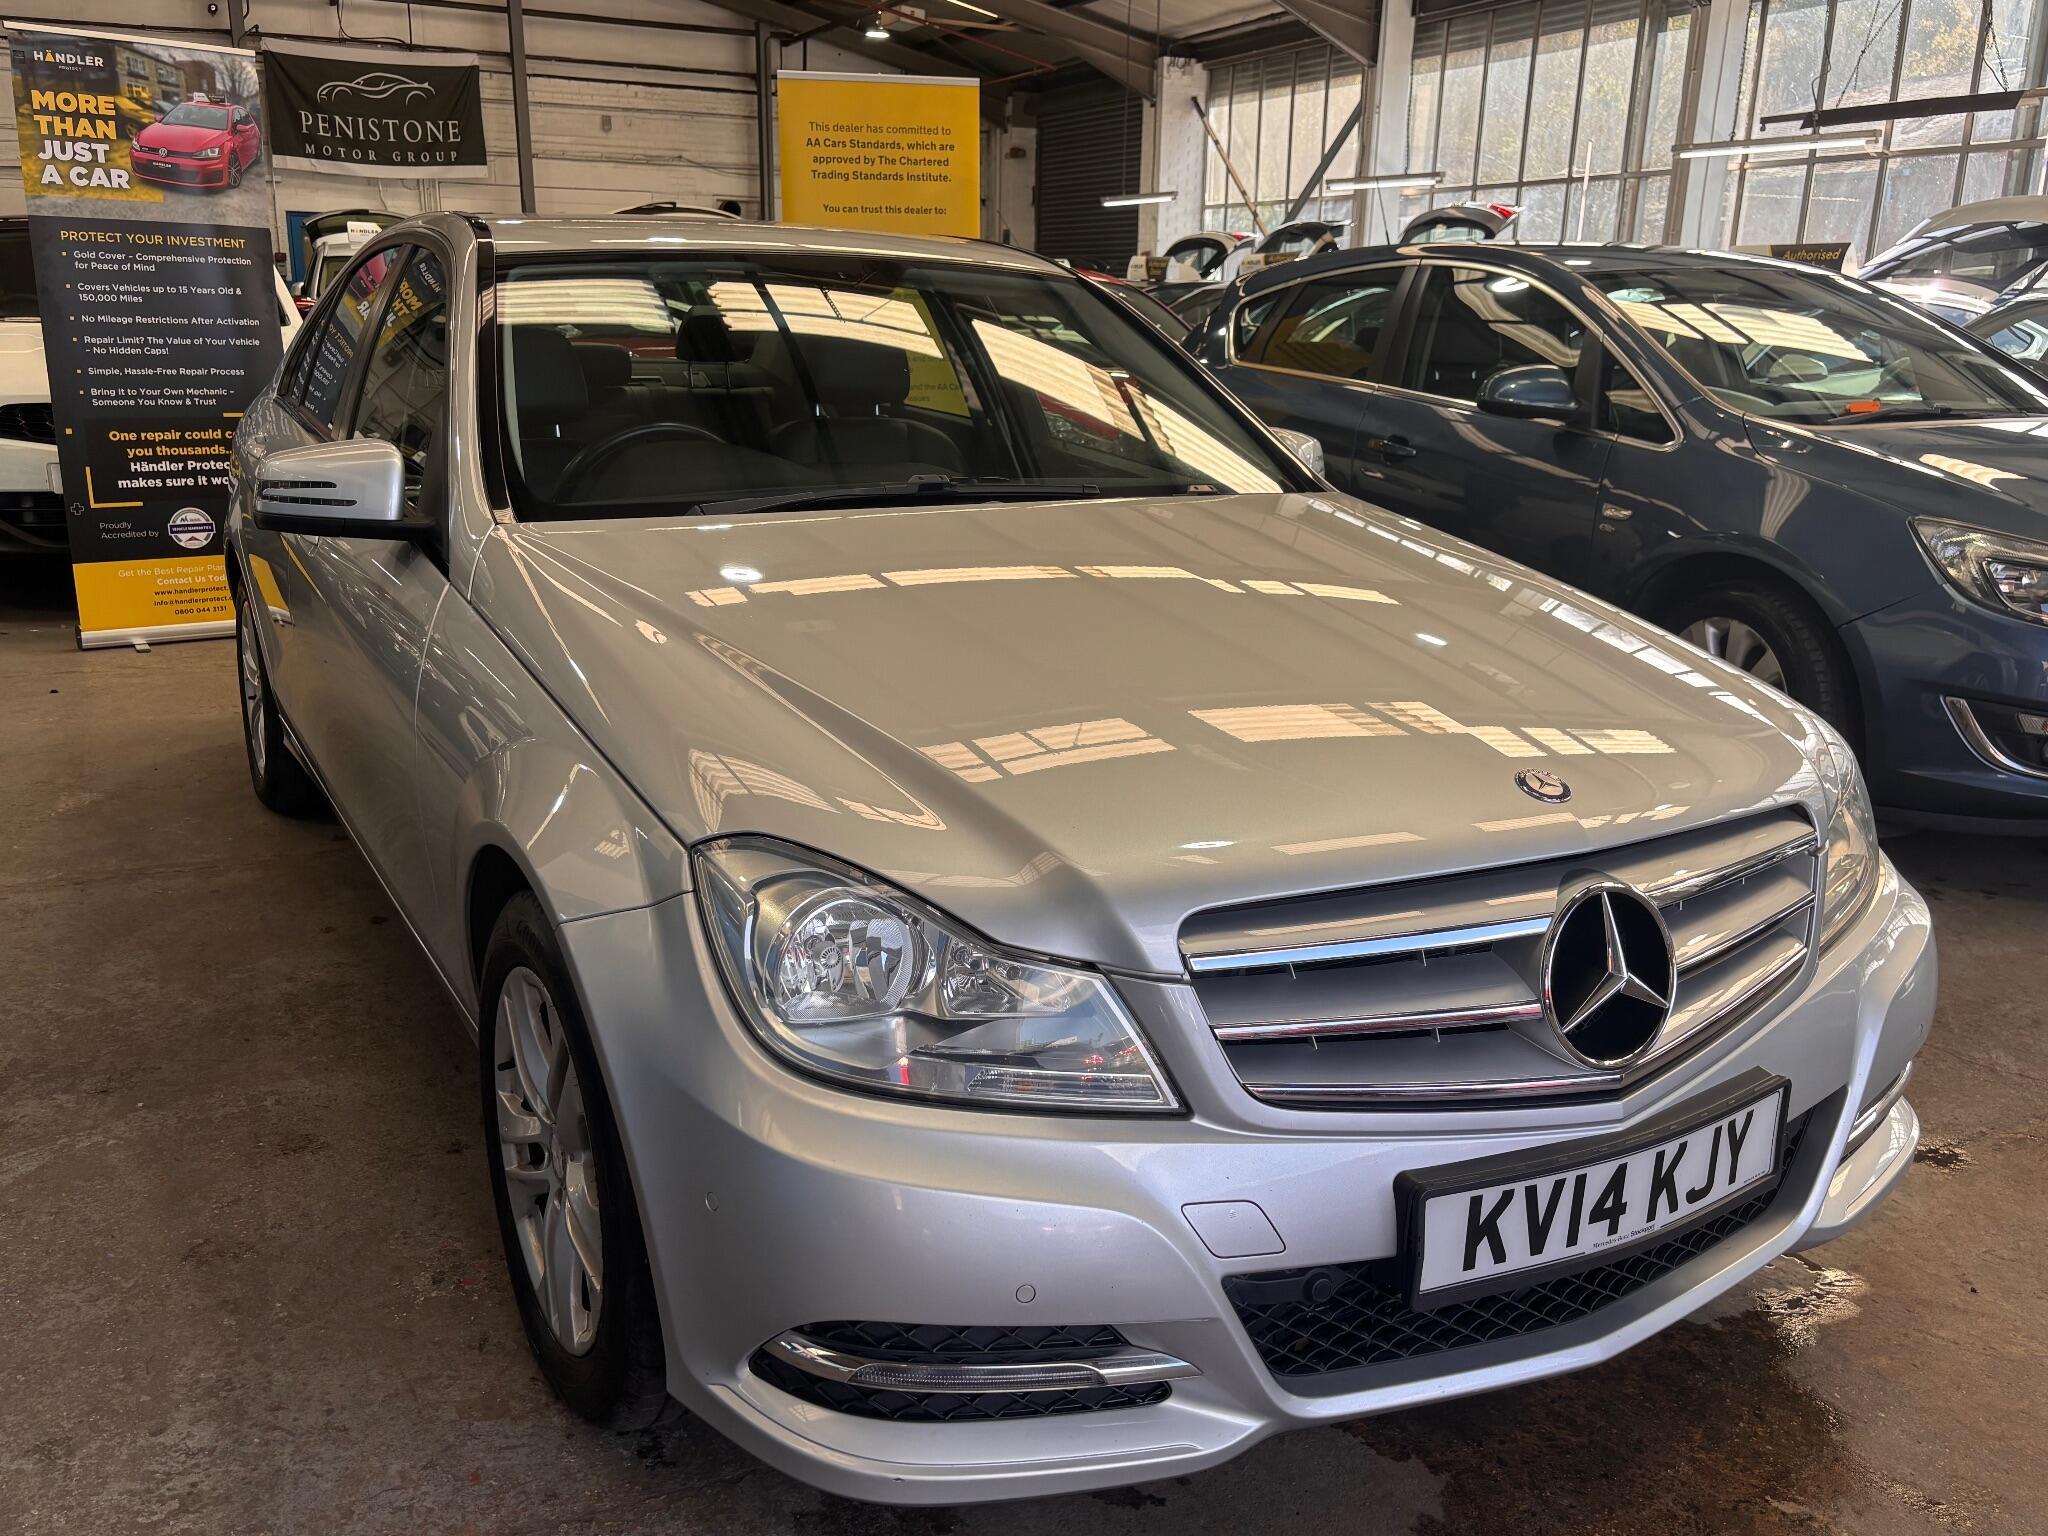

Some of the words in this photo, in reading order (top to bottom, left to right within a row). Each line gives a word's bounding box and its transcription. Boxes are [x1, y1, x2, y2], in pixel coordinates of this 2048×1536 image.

[33, 50, 104, 67] HÄNDLER
[31, 90, 116, 116] MORE
[33, 114, 117, 140] THAN
[300, 110, 461, 143] PENISTONE
[809, 122, 830, 132] This
[833, 122, 864, 133] dealer
[867, 124, 883, 134] has
[886, 125, 939, 135] committed
[942, 127, 951, 135] to
[806, 138, 820, 148] AA
[823, 139, 846, 148] Cars
[850, 139, 904, 150] Standards,
[907, 141, 936, 151] which
[939, 143, 955, 151] are
[38, 140, 110, 163] JUST
[305, 144, 377, 161] MOTOR
[393, 151, 457, 162] GROUP
[812, 155, 860, 165] approved
[864, 156, 875, 166] by
[878, 156, 897, 165] The
[899, 156, 949, 166] Chartered
[41, 164, 63, 185] A
[69, 166, 130, 189] CAR
[811, 170, 849, 181] Trading
[852, 171, 904, 181] Standards
[907, 172, 951, 182] Institute.
[823, 204, 840, 213] You
[861, 205, 882, 214] trust
[885, 206, 902, 214] this
[904, 206, 932, 215] dealer
[935, 207, 947, 215] to:
[60, 230, 122, 243] PROTECT
[126, 234, 163, 245] YOUR
[167, 235, 245, 249] INVESTMENT
[74, 251, 96, 259] Gold
[98, 252, 126, 260] Cover
[136, 253, 205, 263] Comprehensive
[208, 256, 251, 266] Protection
[1783, 249, 1842, 260] Authorised
[75, 261, 88, 269] for
[91, 262, 118, 271] Peace
[122, 263, 131, 271] of
[133, 264, 155, 272] Mind
[77, 283, 110, 292] Covers
[112, 284, 150, 293] Vehicles
[153, 286, 164, 295] up
[167, 286, 176, 294] to
[179, 286, 188, 294] 15
[190, 286, 216, 295] Years
[217, 287, 233, 295] Old
[79, 294, 117, 303] 150,000
[120, 295, 143, 303] Miles
[81, 315, 95, 323] No
[98, 315, 133, 324] Mileage
[136, 316, 189, 325] Restrictions
[191, 317, 213, 325] After
[216, 318, 260, 326] Activation
[84, 336, 115, 345] Repair
[117, 336, 144, 345] Limit?
[147, 337, 164, 345] The
[166, 337, 191, 345] Value
[194, 337, 204, 345] of
[205, 337, 227, 346] Your
[229, 338, 260, 346] Vehicle
[109, 347, 142, 355] Hidden
[144, 347, 169, 356] Caps!
[88, 367, 122, 376] Simple,
[124, 367, 177, 376] Hassle-Free
[180, 368, 208, 376] Repair
[210, 368, 245, 376] Process
[91, 388, 116, 397] Bring
[118, 388, 125, 396] it
[127, 388, 137, 396] to
[139, 388, 161, 396] Your
[163, 388, 184, 396] Own
[186, 388, 227, 396] Mechanic
[92, 398, 135, 406] Someone
[138, 398, 155, 406] You
[157, 398, 183, 406] Know
[186, 398, 191, 406] &
[194, 398, 216, 406] Trust
[109, 431, 137, 442] One
[141, 430, 180, 442] repair
[185, 429, 222, 440] could
[127, 447, 152, 458] you
[130, 461, 183, 472] Händler
[188, 460, 230, 470] Protec
[118, 477, 162, 488] makes
[166, 477, 195, 487] sure
[198, 475, 208, 486] it
[100, 522, 132, 530] Proudly
[102, 530, 146, 539] Accredited
[149, 530, 159, 538] by
[118, 569, 134, 577] Get
[137, 568, 151, 576] the
[154, 567, 174, 575] Best
[177, 565, 204, 574] Repair
[157, 577, 193, 586] Contact
[208, 574, 227, 582] Tod
[175, 607, 194, 615] 0800
[1463, 1162, 1628, 1271] KV14
[1646, 1110, 1755, 1223] KJY
